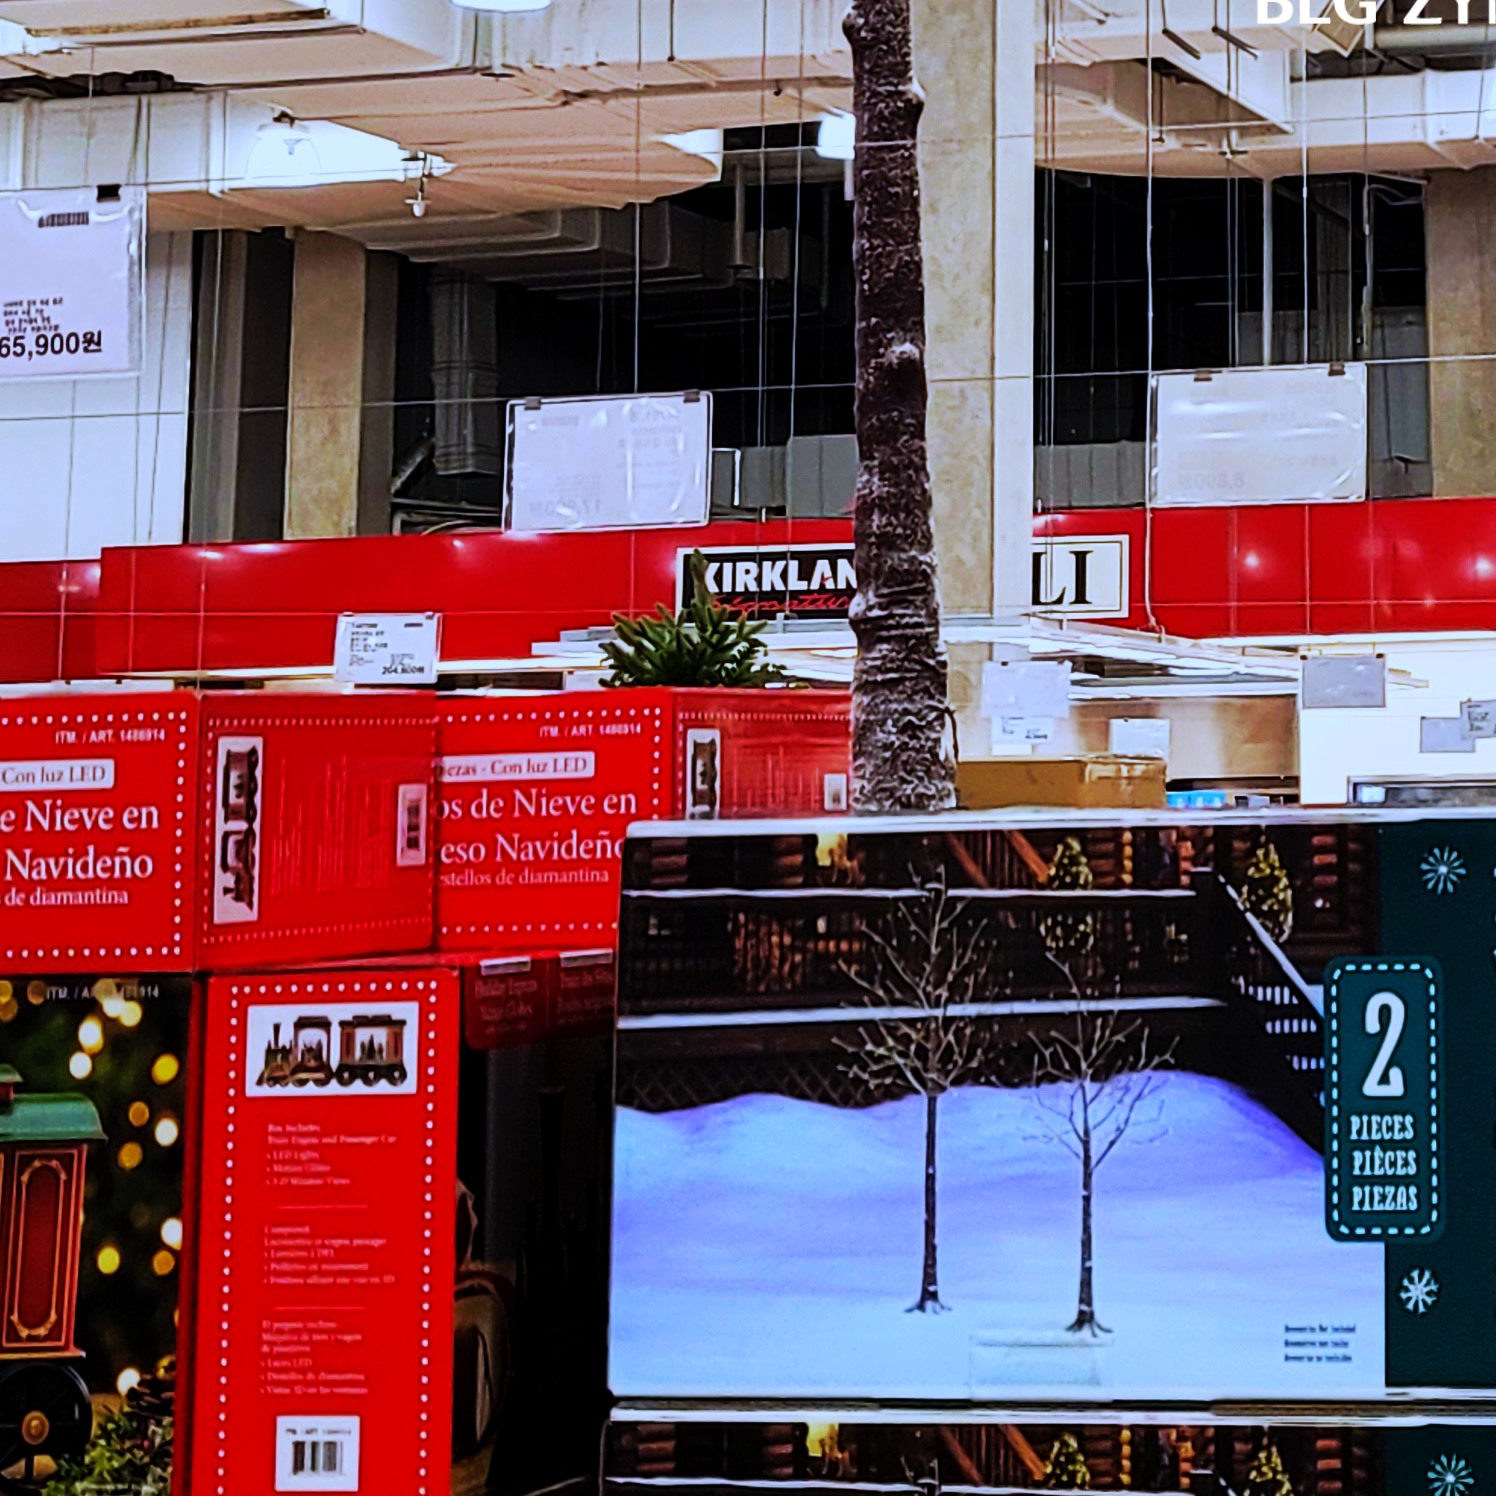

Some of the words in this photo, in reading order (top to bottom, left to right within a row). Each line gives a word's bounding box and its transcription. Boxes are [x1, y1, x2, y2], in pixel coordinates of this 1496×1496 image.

[0, 329, 102, 361] 65,900원
[704, 558, 858, 593] KIRKLAN
[1, 766, 36, 785] Con
[40, 765, 65, 784] luz
[69, 764, 106, 783] LED
[490, 759, 522, 775] Con
[526, 758, 548, 773] luz
[552, 757, 587, 773] LED
[0, 808, 16, 833] e
[24, 798, 115, 832] Nieve
[122, 804, 159, 830] en
[470, 787, 504, 820] de
[512, 787, 596, 819] Nieve
[602, 792, 637, 815] en
[4, 844, 154, 882] Navideño
[440, 840, 486, 864] eso
[440, 868, 492, 887] stellos
[495, 867, 515, 885] de
[518, 866, 609, 885] diamantina
[4, 886, 25, 906] de
[29, 885, 129, 906] diamantina
[1362, 991, 1405, 1097] 2
[1349, 1114, 1414, 1141] PIECES
[1352, 1144, 1417, 1176] PIÈCES
[1351, 1185, 1418, 1212] PIEZAS
